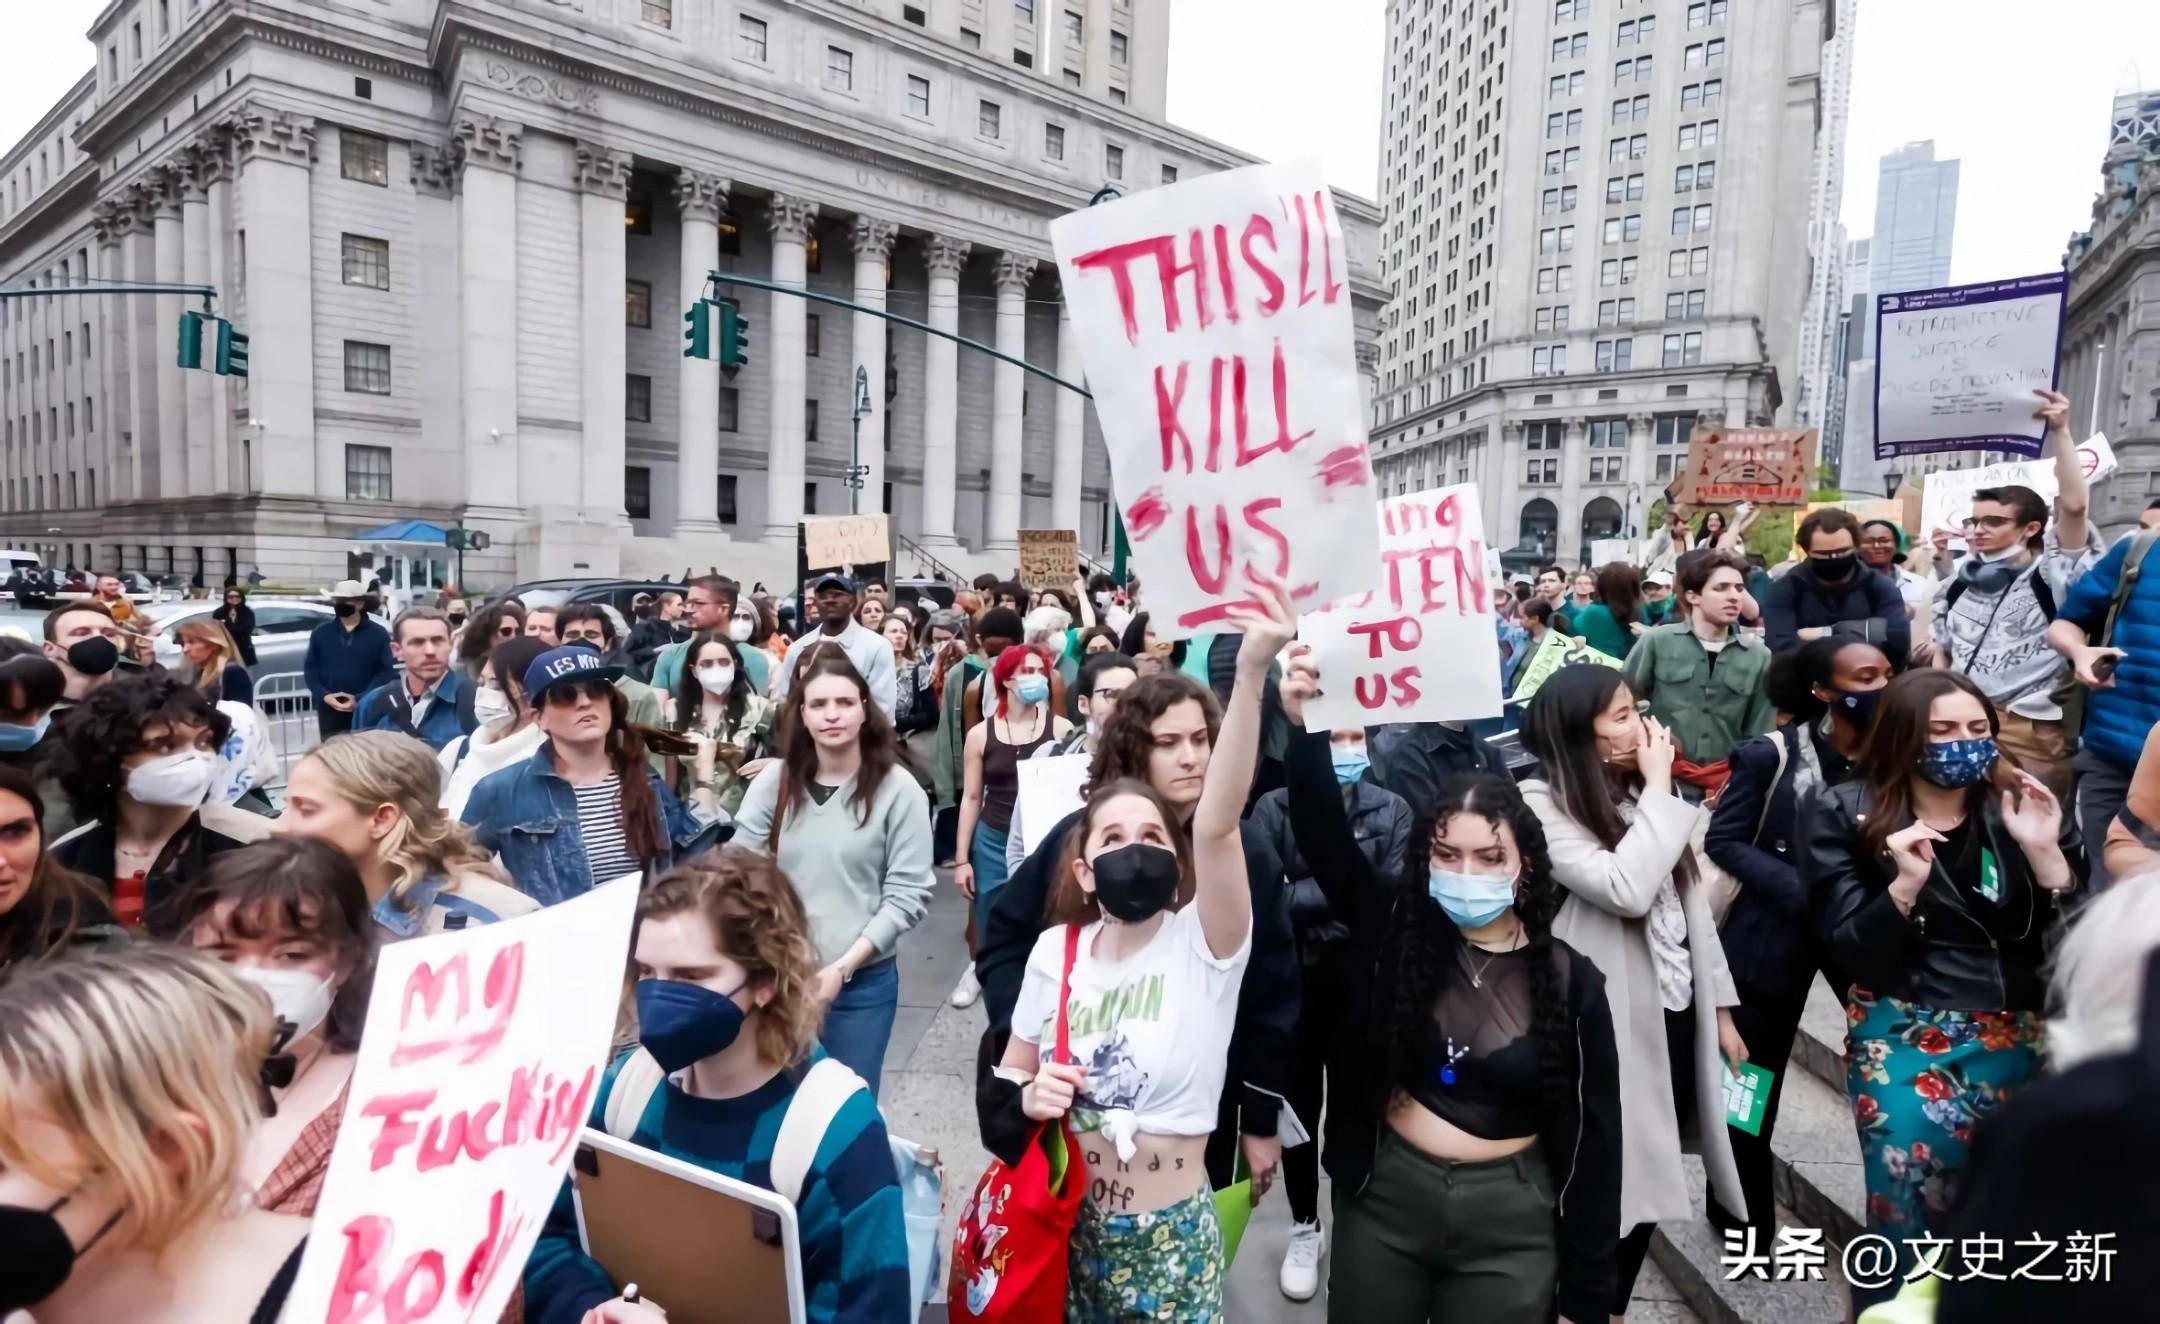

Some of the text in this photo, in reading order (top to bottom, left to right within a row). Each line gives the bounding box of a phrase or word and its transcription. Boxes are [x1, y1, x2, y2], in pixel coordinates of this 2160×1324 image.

[1071, 191, 1342, 347] THIS'LL
[1154, 337, 1316, 475] KILL
[1185, 497, 1290, 596] US
[1347, 616, 1422, 659] TO
[545, 656, 576, 679] LES
[1355, 666, 1422, 710] US
[1092, 1177, 1135, 1210] Off
